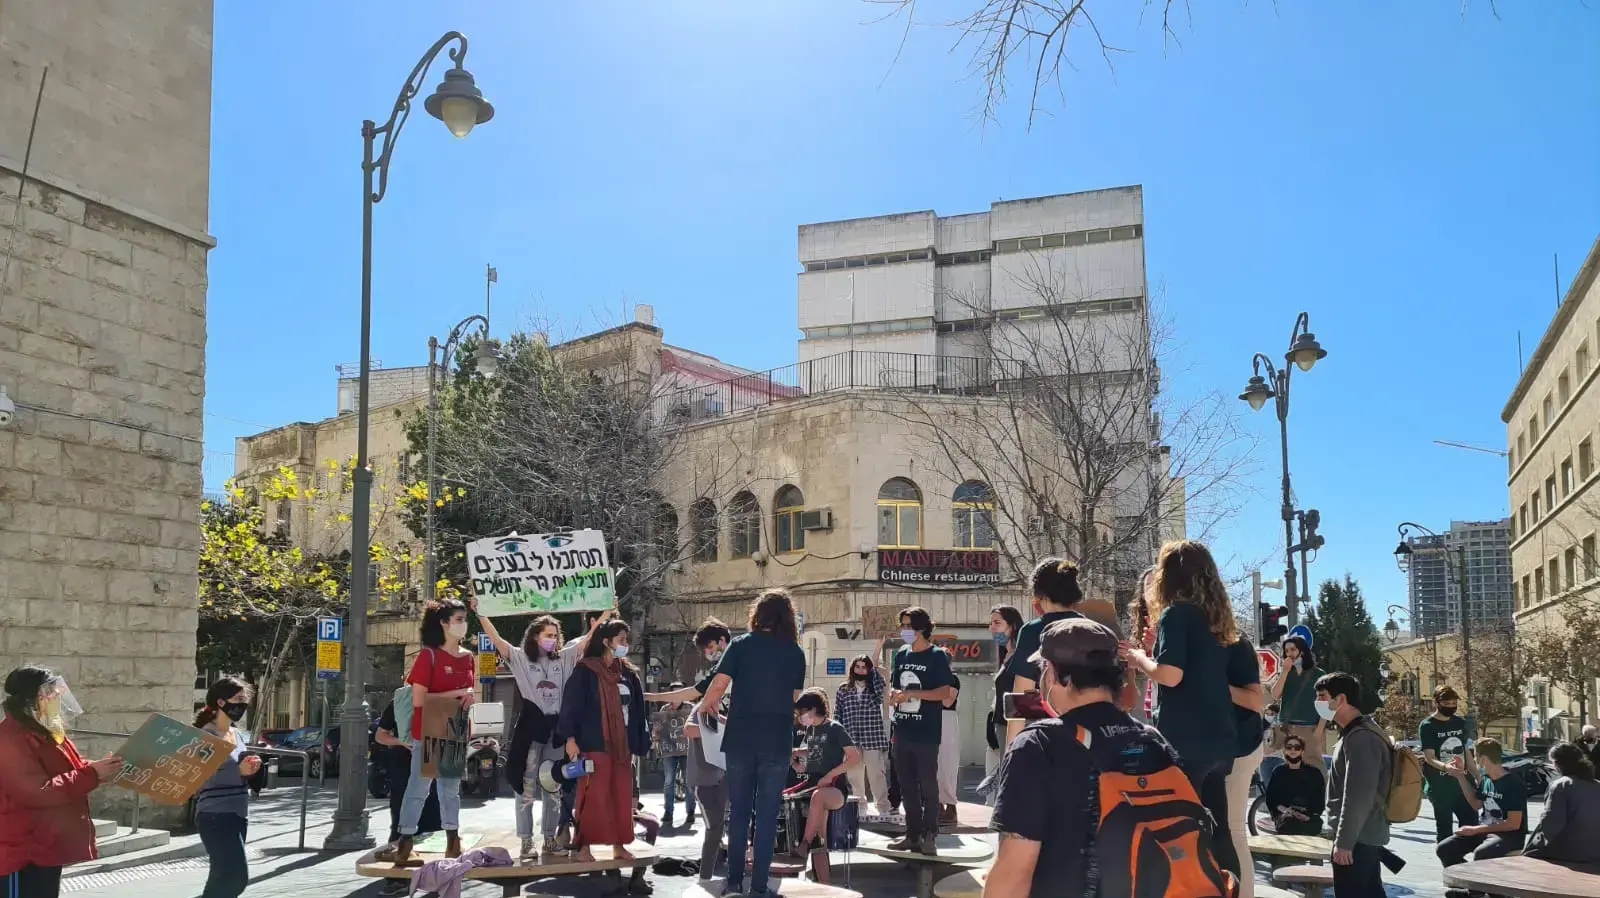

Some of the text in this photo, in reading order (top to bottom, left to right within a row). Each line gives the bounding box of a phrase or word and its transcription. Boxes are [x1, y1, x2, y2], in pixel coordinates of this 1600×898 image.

[529, 551, 544, 569] לי
[549, 548, 603, 571] תסתכלו
[882, 551, 999, 569] MANDARIN
[526, 575, 550, 591] הרי
[552, 575, 568, 590] את
[572, 571, 609, 589] ותצילו
[881, 569, 1000, 582] Chinese restaurant
[176, 737, 215, 764] לא
